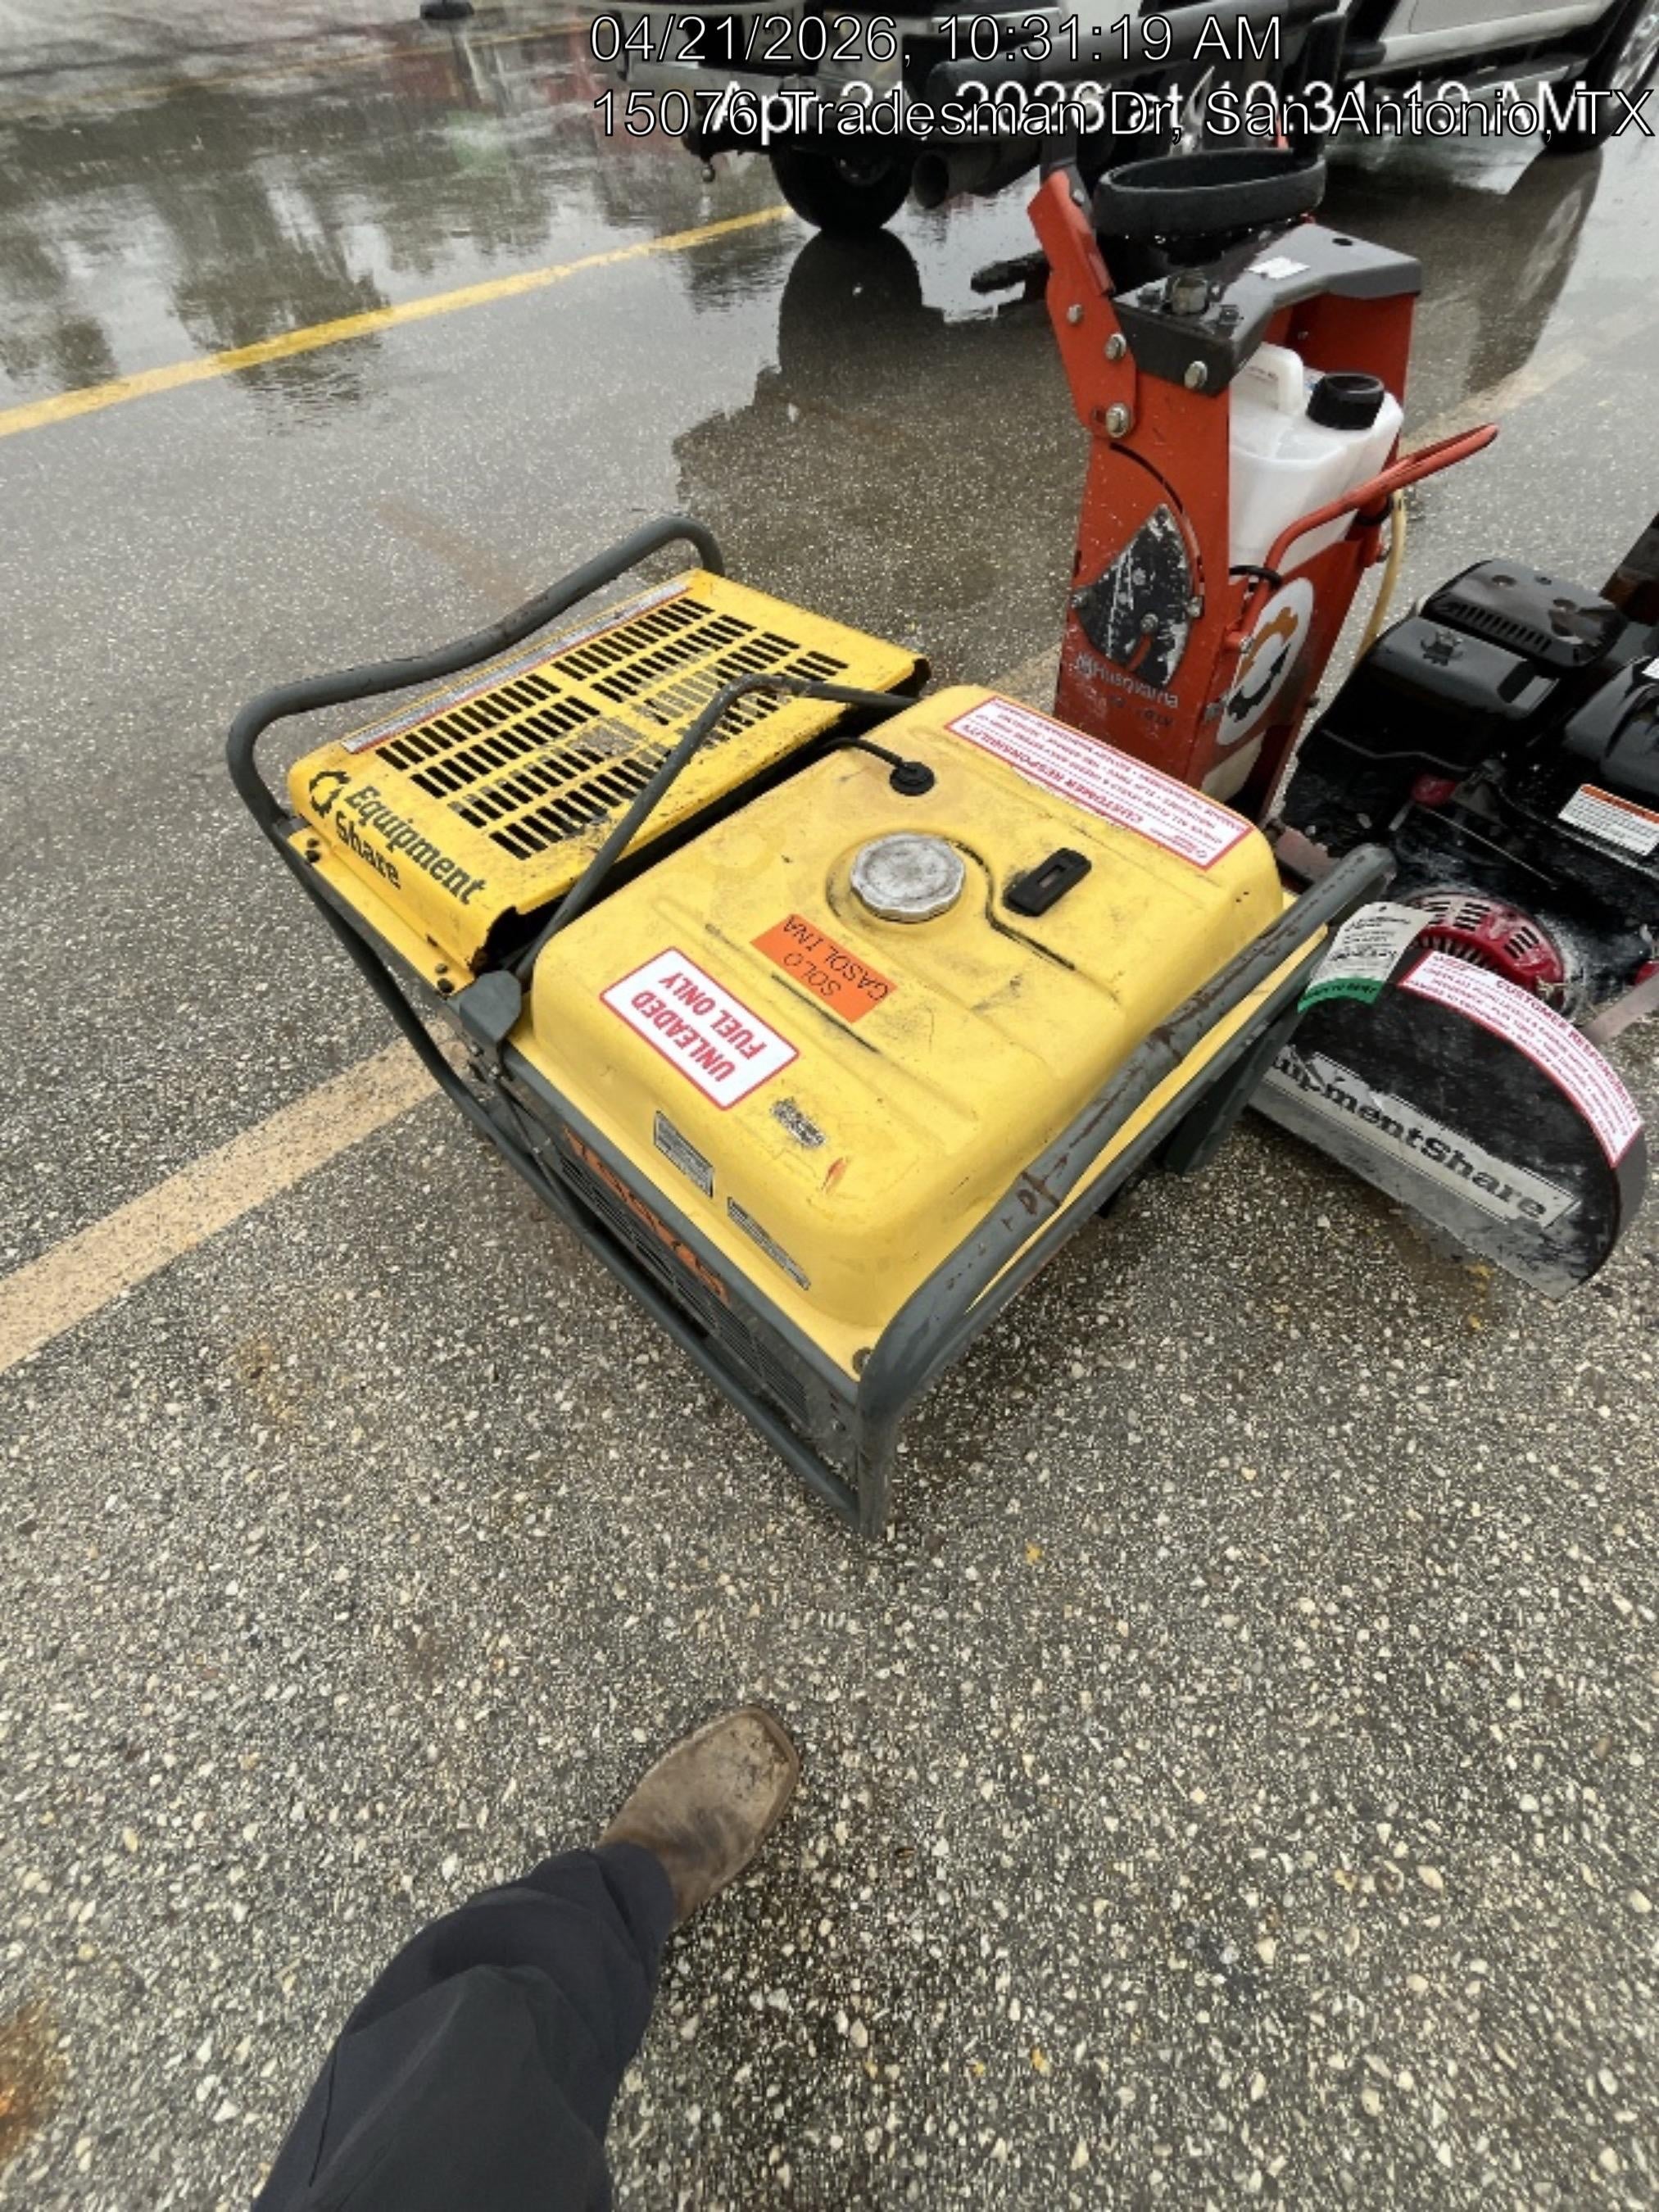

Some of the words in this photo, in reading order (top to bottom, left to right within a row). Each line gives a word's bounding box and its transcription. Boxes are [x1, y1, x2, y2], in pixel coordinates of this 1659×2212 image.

[336, 809, 401, 890] Share
[344, 785, 487, 905] Equipment
[658, 972, 716, 1016] ONLY
[782, 915, 890, 1002] GASOLINA
[782, 952, 842, 997] SOLO
[631, 990, 736, 1082] UNLEADED
[709, 1009, 768, 1060] FUEL
[1271, 1057, 1547, 1221] uipmentShare
